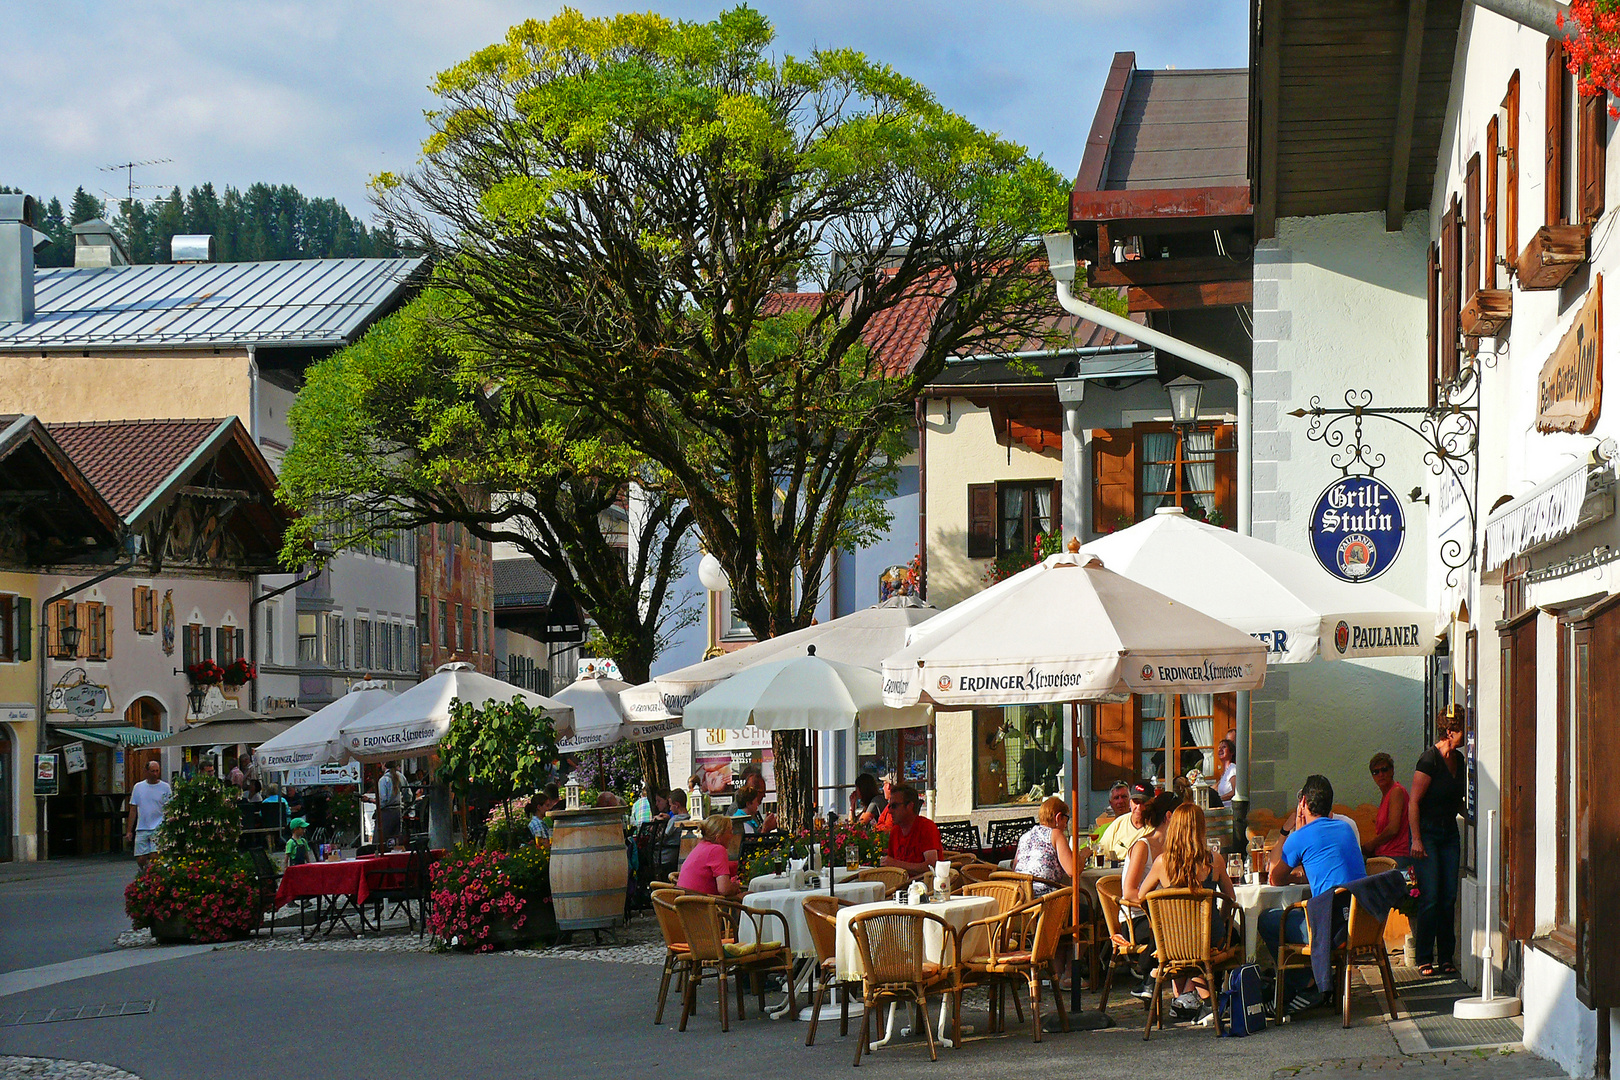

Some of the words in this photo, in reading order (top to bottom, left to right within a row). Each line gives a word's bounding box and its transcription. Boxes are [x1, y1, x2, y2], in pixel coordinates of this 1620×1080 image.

[1327, 484, 1389, 509] Grill-
[1320, 508, 1392, 534] Stub'n
[1339, 534, 1375, 554] PAULANER
[1352, 624, 1420, 649] PAULANER
[1157, 665, 1203, 682] ERDINGER
[959, 675, 1026, 692] ERDINGER
[641, 722, 666, 735] ERDINGER
[706, 728, 726, 745] 30
[363, 732, 402, 747] ERDINGER
[268, 754, 293, 765] ERDINGER
